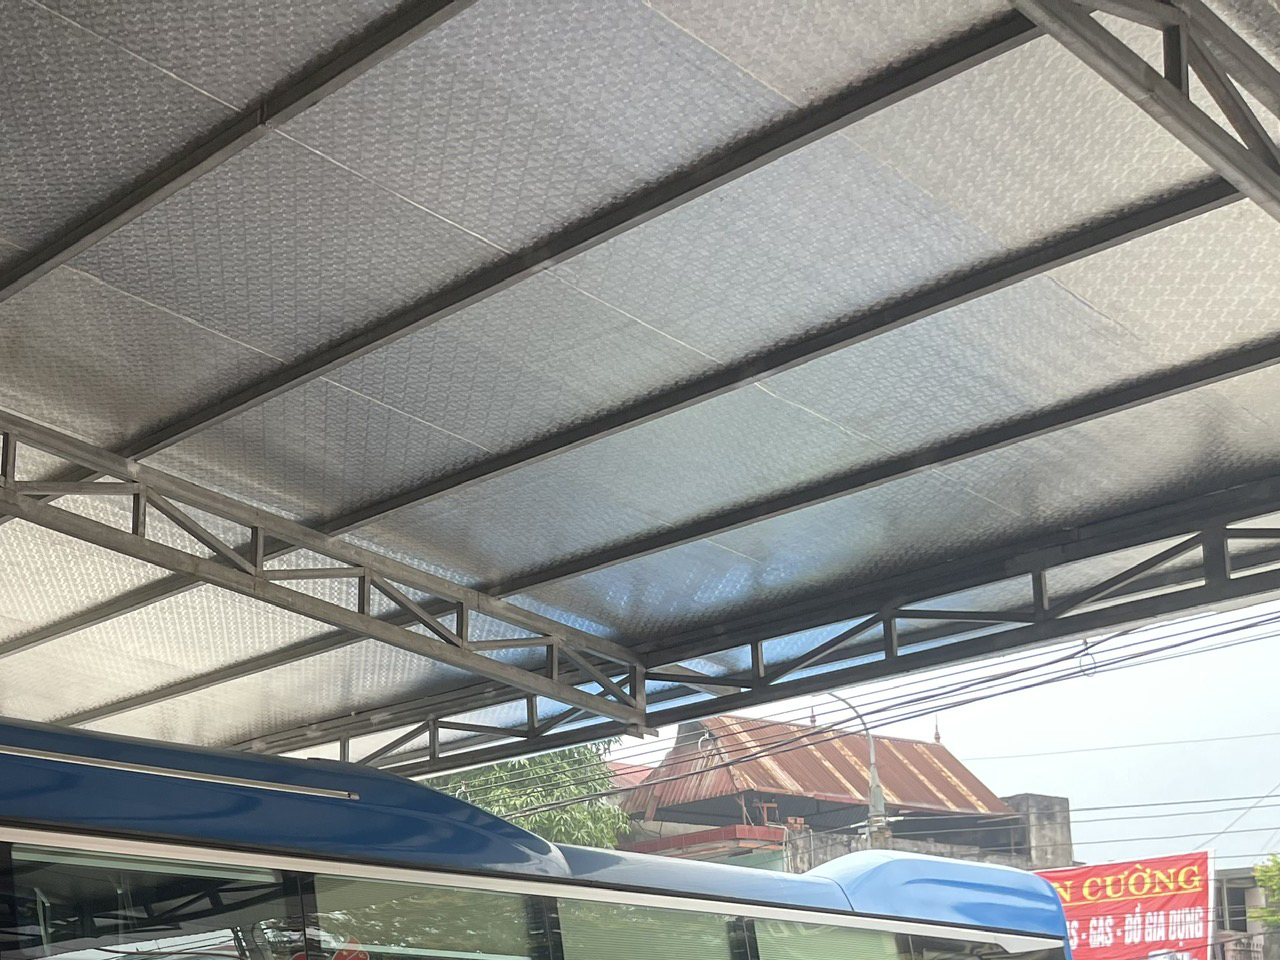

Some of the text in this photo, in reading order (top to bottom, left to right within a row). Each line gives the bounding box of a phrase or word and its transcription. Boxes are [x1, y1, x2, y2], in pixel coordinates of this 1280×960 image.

[1082, 864, 1201, 900] CƯỜNG
[1089, 916, 1114, 948] GAS
[1145, 911, 1165, 942] GIA
[1168, 906, 1204, 947] DỤNG
